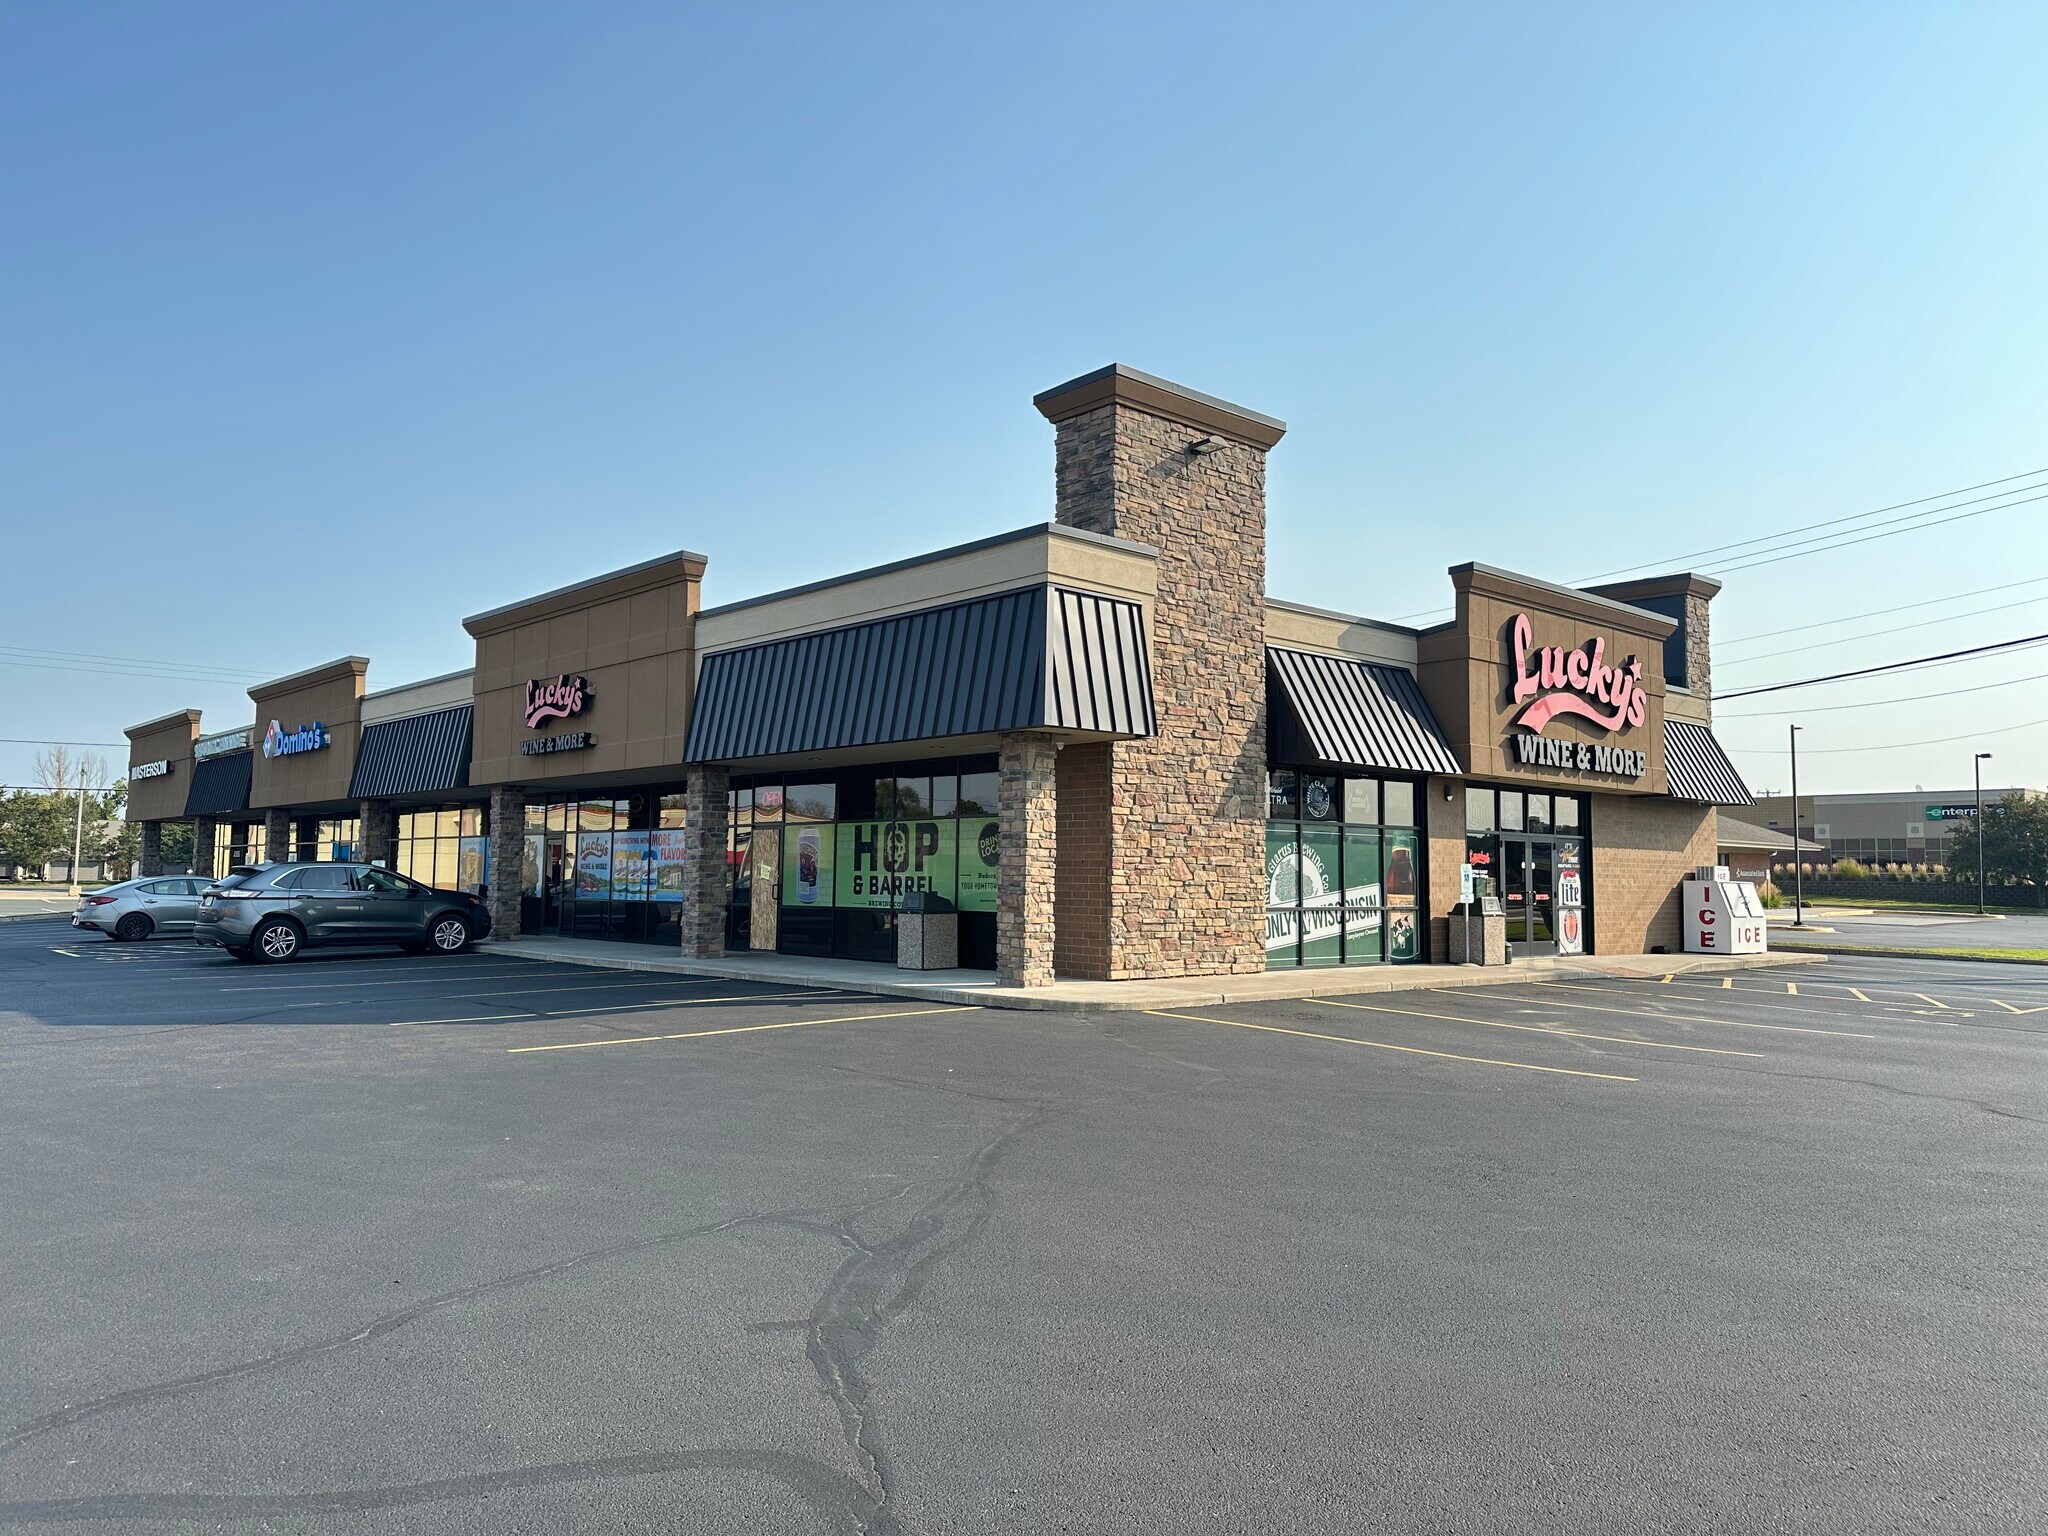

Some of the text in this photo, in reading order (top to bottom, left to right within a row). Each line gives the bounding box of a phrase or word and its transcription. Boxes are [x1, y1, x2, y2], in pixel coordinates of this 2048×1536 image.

[1514, 613, 1647, 734] Lucky's
[524, 674, 583, 729] Lucky's
[273, 721, 320, 757] Domino's
[521, 732, 585, 755] WINE & MORE
[1517, 734, 1647, 777] WINE & MORE
[131, 760, 167, 780] MASTERSON
[761, 790, 784, 807] OPEN
[1926, 807, 2006, 818] enterpe
[580, 836, 609, 861] Lucky's
[651, 833, 671, 846] MORE
[853, 822, 939, 873] HOP
[979, 834, 999, 849] DRIN
[580, 863, 592, 871] WINE
[595, 862, 608, 870] MORE
[1293, 841, 1325, 874] Bewing
[853, 875, 938, 896] & BARREL
[1717, 872, 1726, 880] ICE
[1310, 894, 1378, 930] WISCONSIN
[1698, 886, 1716, 948] ICE
[1738, 926, 1761, 944] ICE
